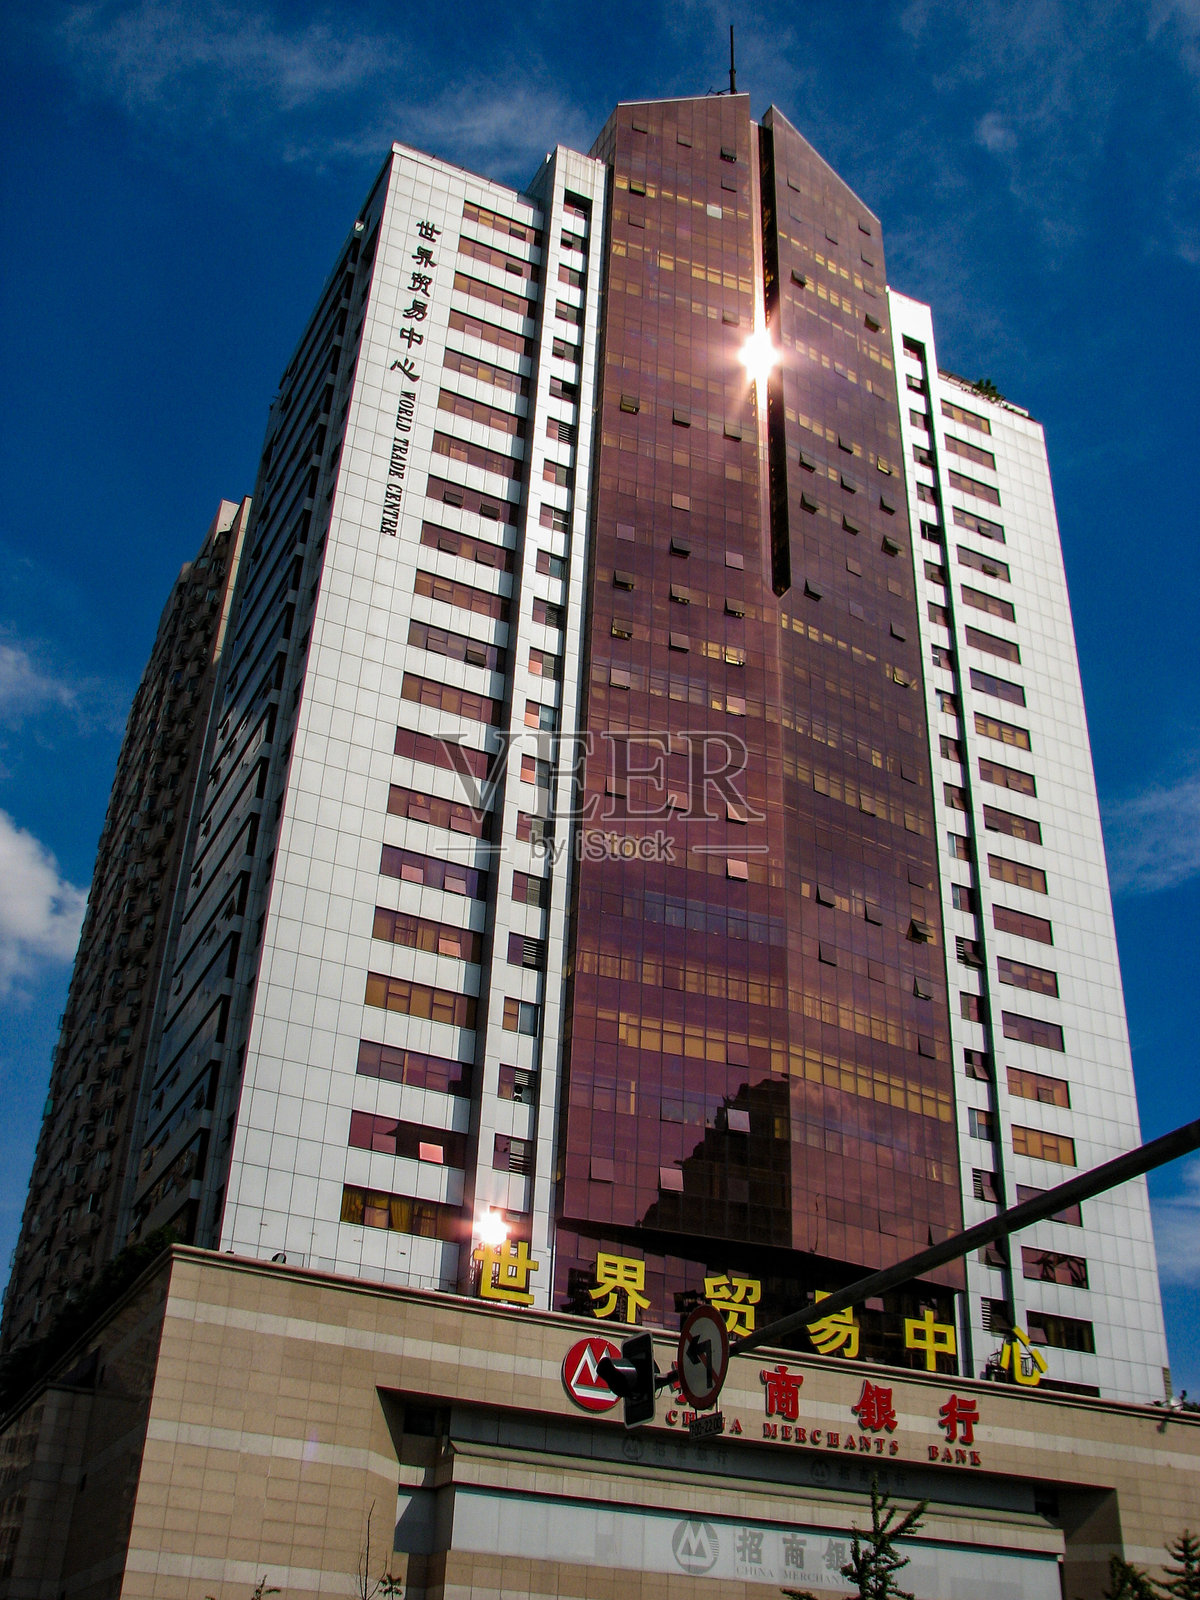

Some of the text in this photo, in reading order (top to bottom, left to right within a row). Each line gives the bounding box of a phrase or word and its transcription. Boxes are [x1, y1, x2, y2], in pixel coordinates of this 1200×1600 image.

[389, 219, 442, 383] 世界贸易中心
[380, 391, 417, 537] WORLD TRADE CENTRE
[473, 1238, 1049, 1387] 世界贸易中心
[763, 1422, 900, 1456] MERCHANTS
[927, 1445, 983, 1467] BANK
[736, 1565, 775, 1579] CHINA
